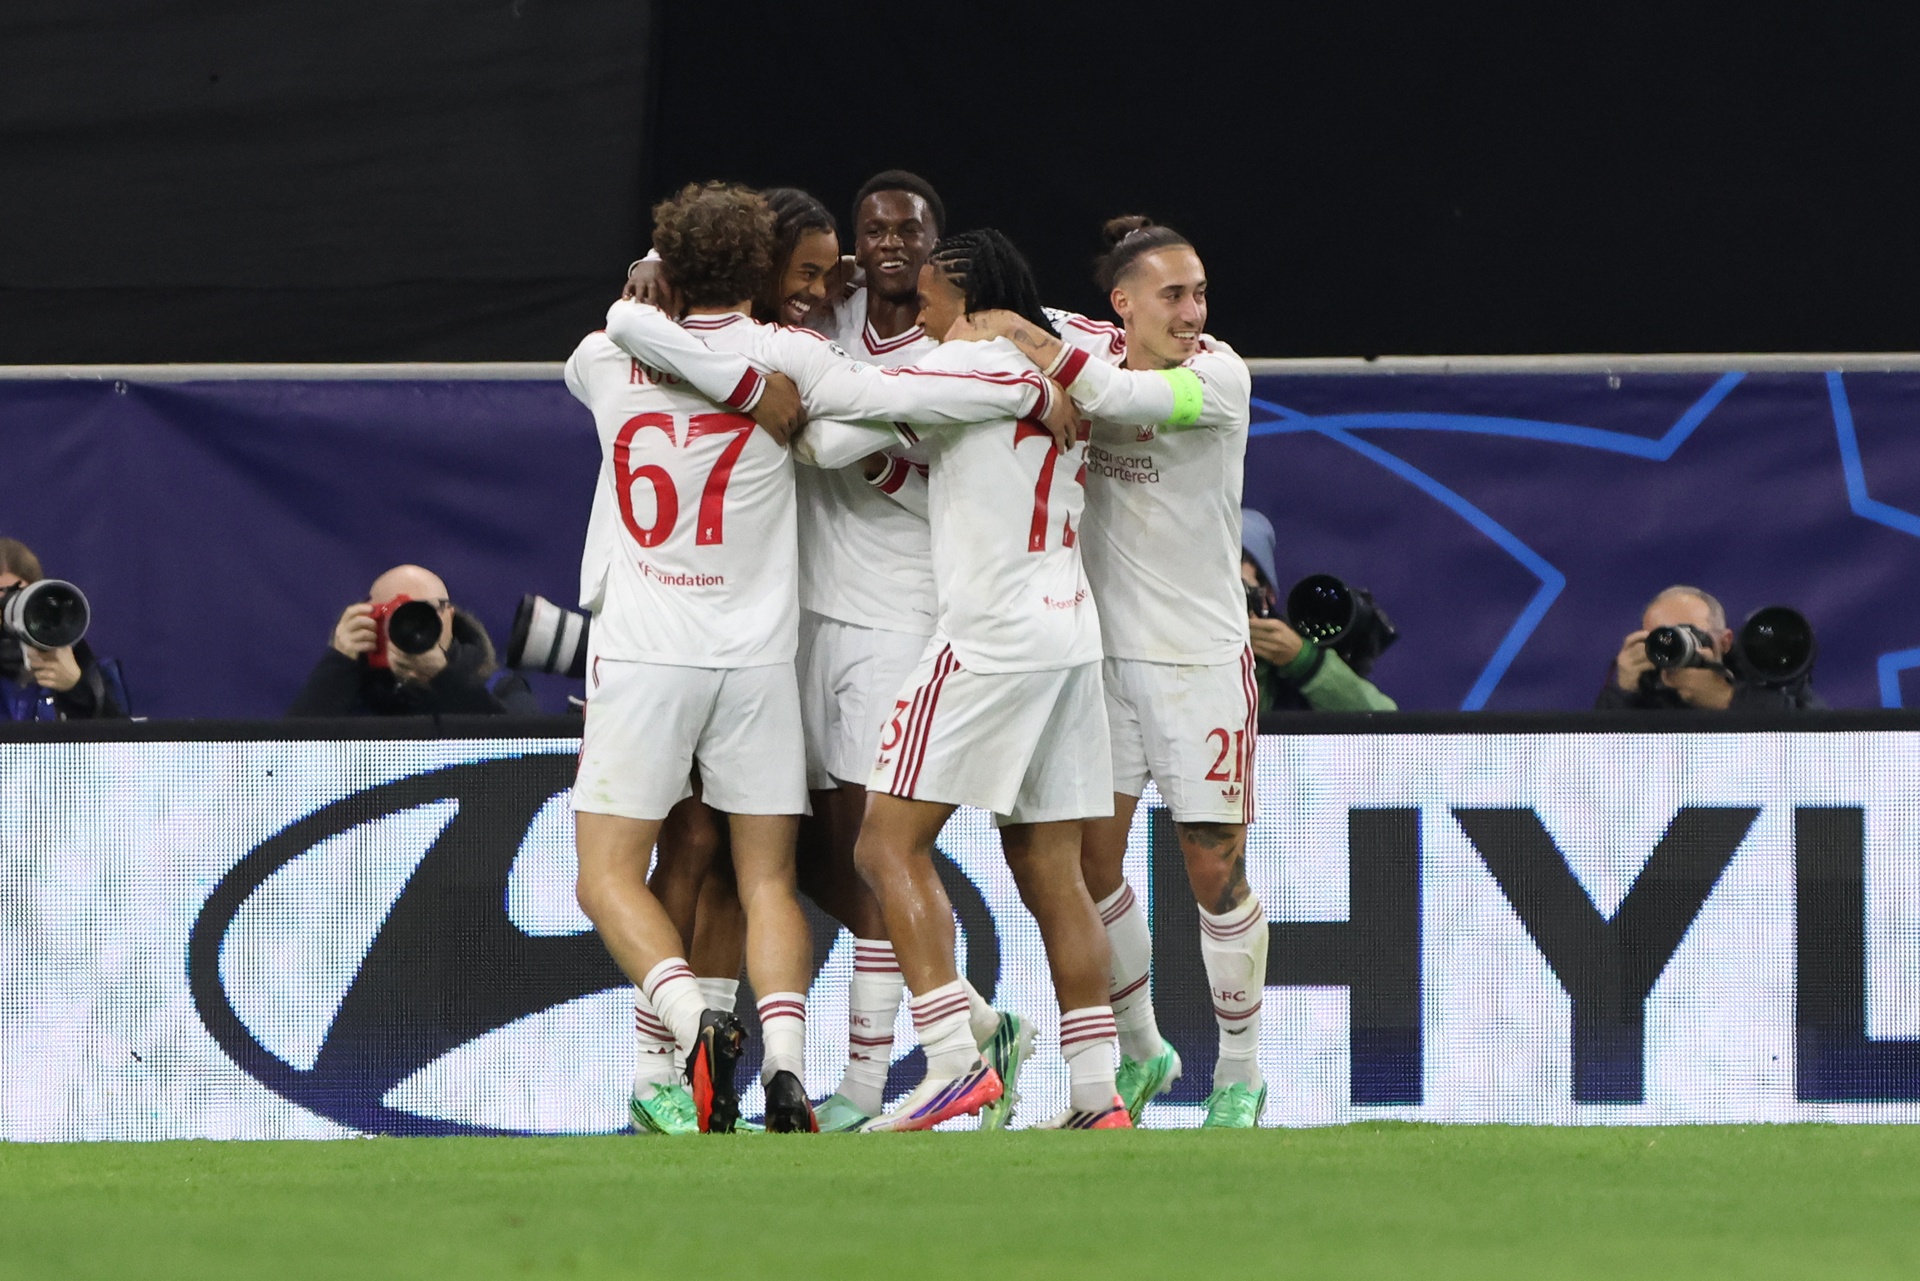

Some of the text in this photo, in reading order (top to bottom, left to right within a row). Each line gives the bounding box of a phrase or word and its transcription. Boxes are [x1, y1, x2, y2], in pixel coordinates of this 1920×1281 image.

[613, 412, 757, 548] 67
[1087, 460, 1159, 484] chartered
[644, 564, 724, 587] Fundation
[1204, 727, 1244, 783] 21
[1212, 986, 1246, 1002] LFC
[851, 1014, 871, 1029] FC
